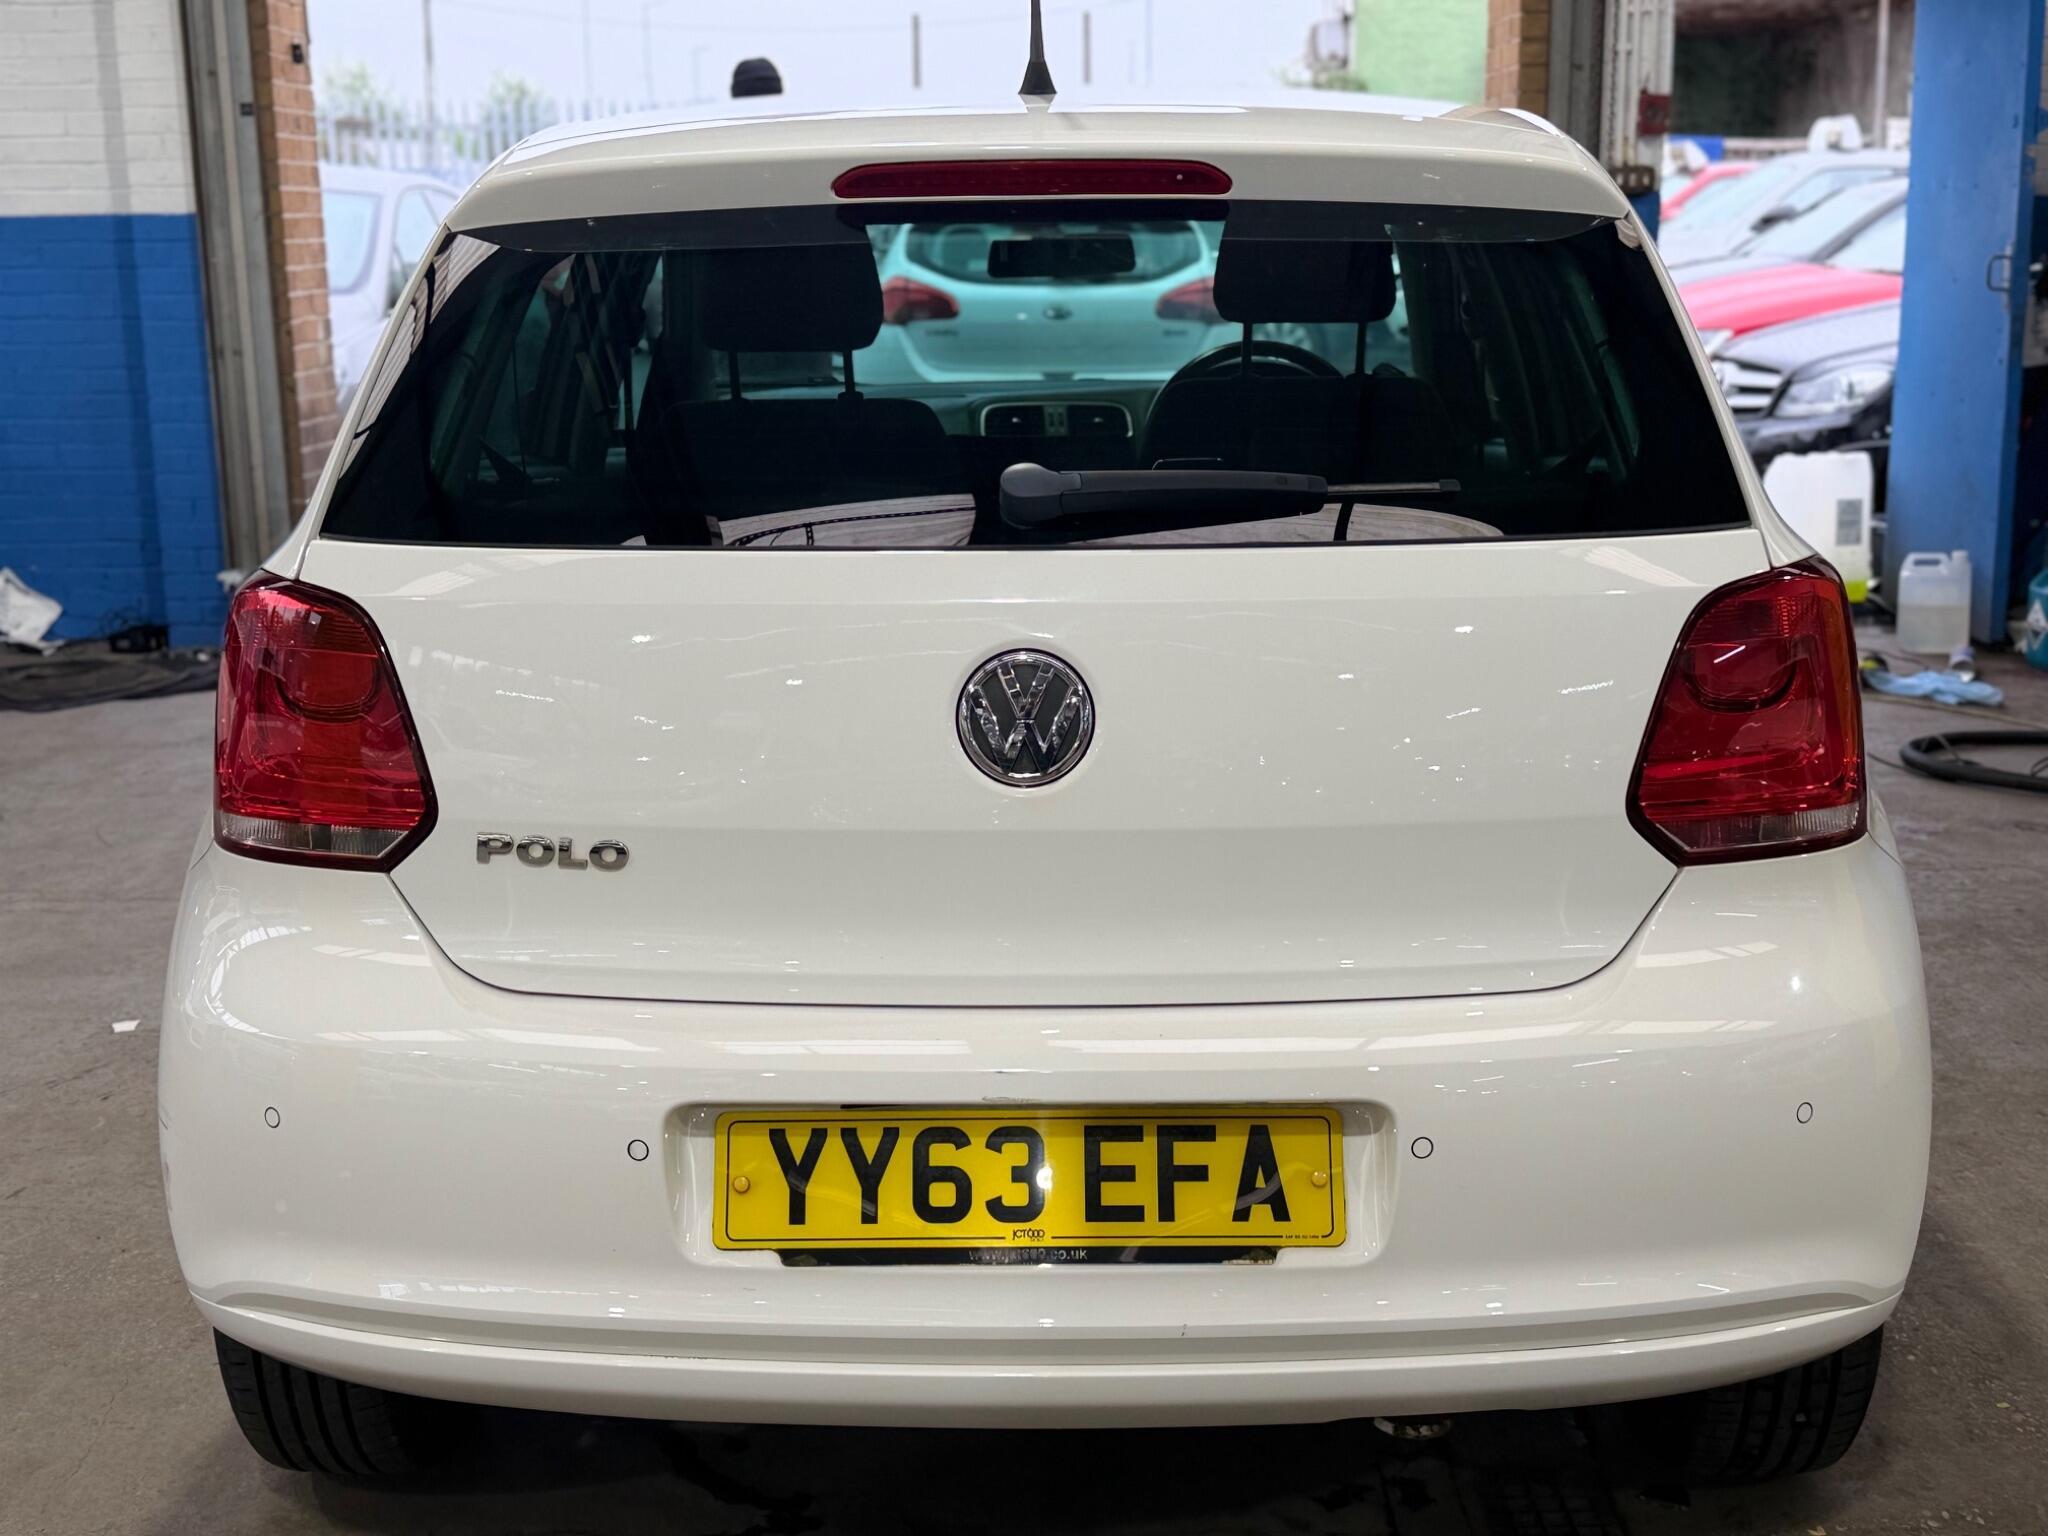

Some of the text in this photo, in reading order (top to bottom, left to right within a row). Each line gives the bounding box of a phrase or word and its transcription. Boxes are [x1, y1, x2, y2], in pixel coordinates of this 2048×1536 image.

[476, 832, 630, 872] POLO
[768, 1125, 1292, 1226] YY63 EFA
